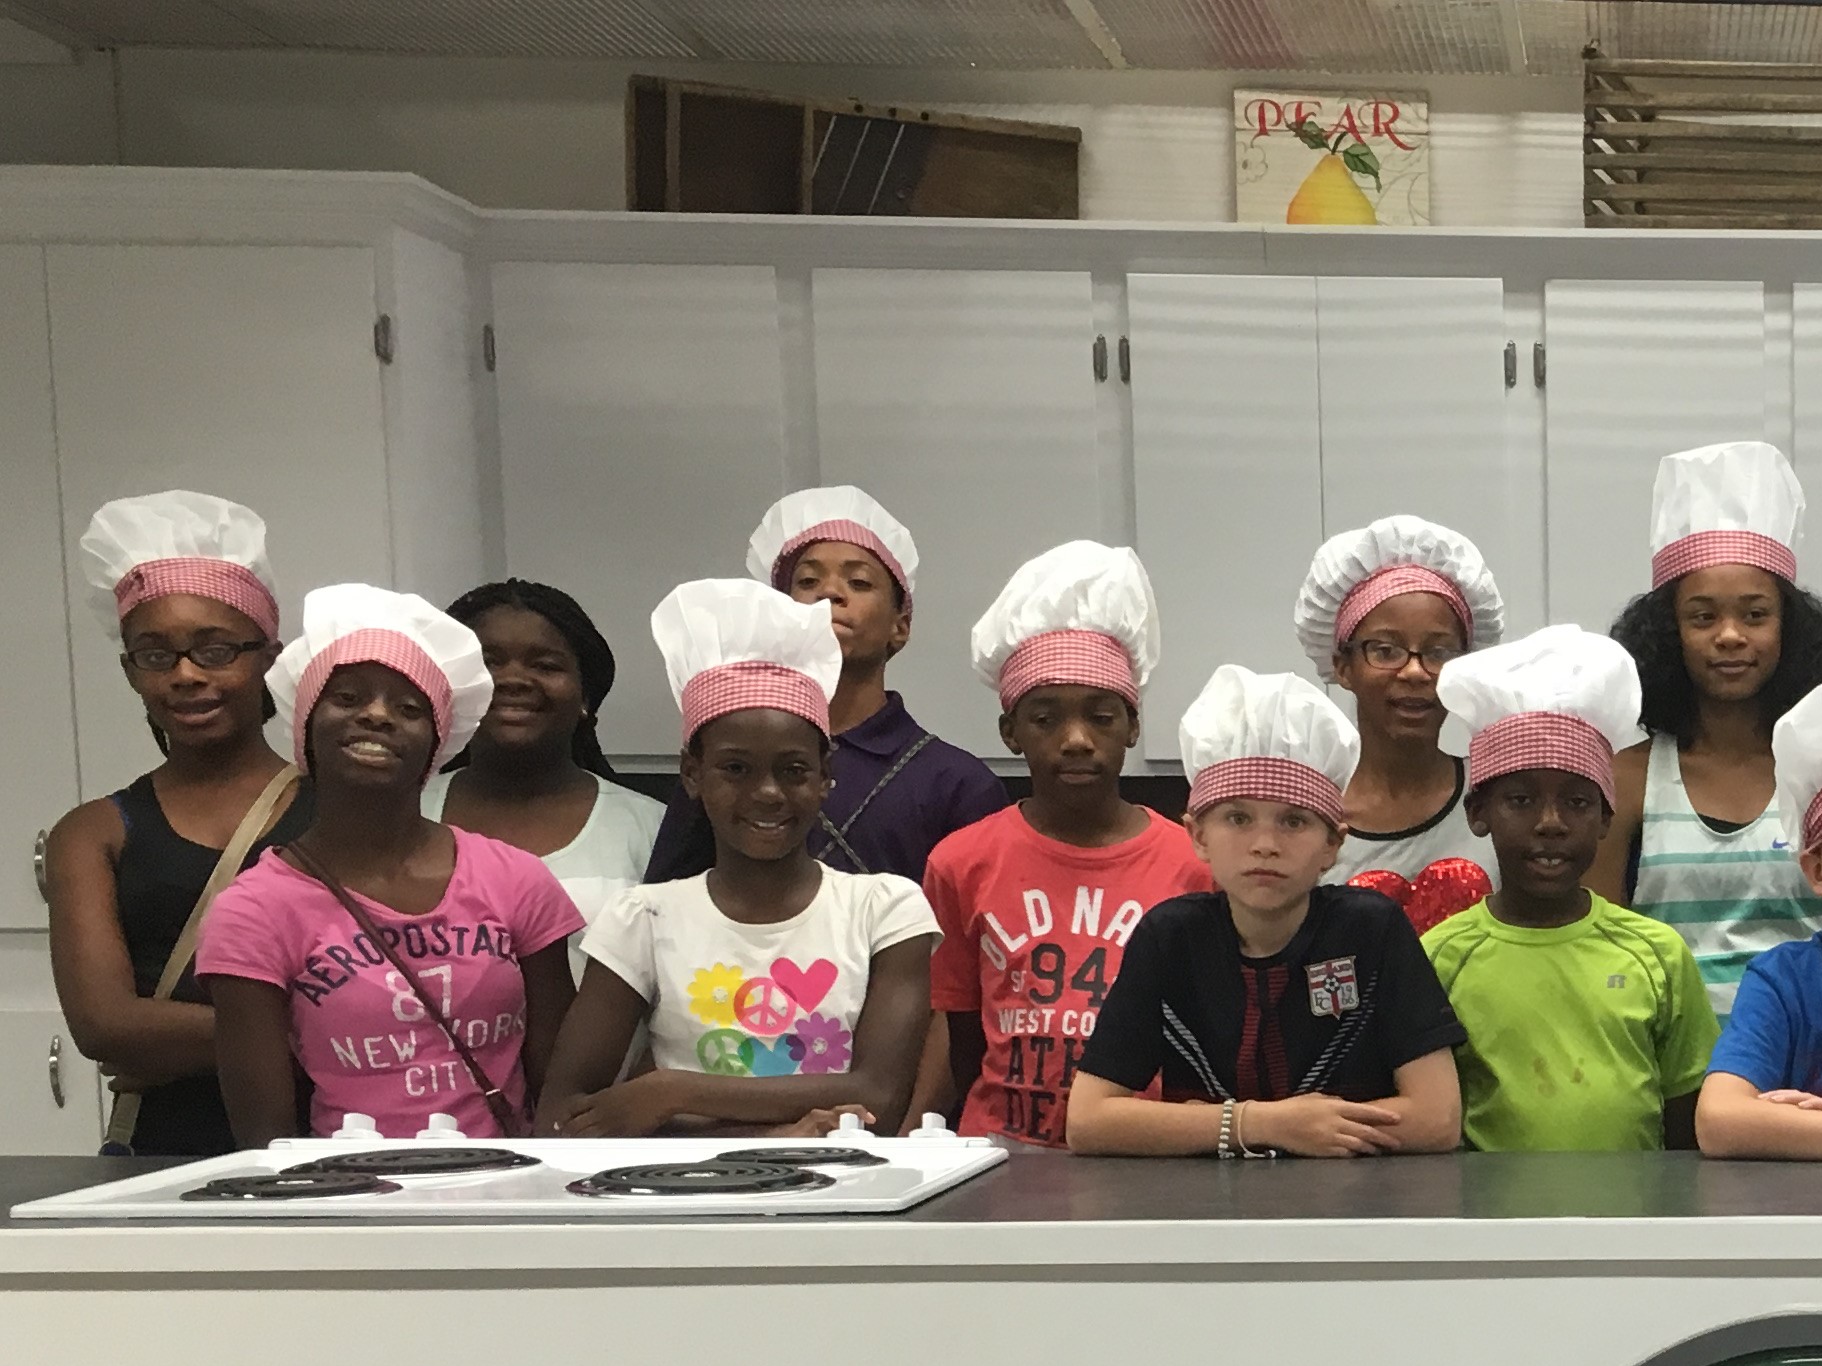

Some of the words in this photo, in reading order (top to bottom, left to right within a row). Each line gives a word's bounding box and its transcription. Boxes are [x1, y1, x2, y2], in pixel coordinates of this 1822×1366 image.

[1244, 98, 1417, 151] PEAR
[979, 888, 1054, 971] OLD
[385, 963, 453, 1022] 87
[1029, 942, 1108, 1008] 94
[999, 1008, 1056, 1035] WEST
[330, 1029, 417, 1071] NEW
